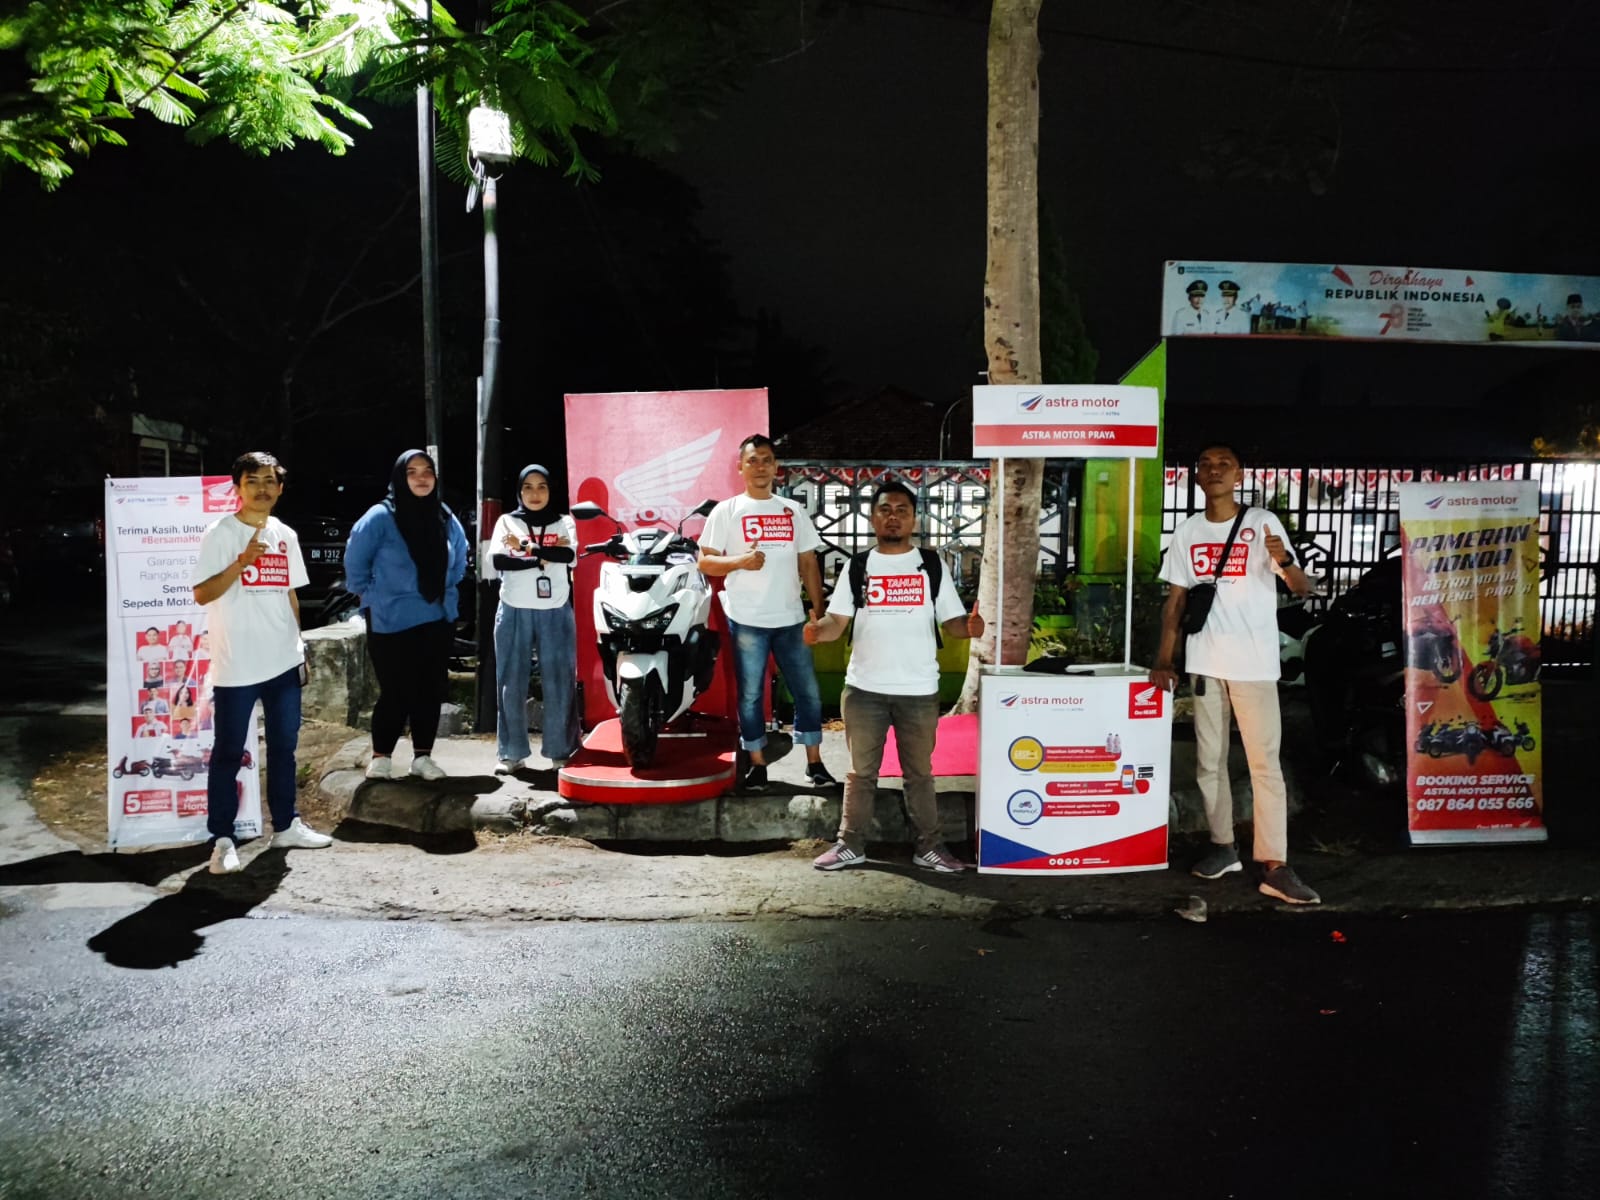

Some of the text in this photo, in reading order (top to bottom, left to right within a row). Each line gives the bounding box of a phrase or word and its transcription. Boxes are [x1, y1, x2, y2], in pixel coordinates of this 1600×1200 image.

[1325, 289, 1485, 303] REPUBLIK INDONESIA
[1045, 396, 1120, 408] astra motor
[1022, 430, 1116, 440] ASTRA MOTOR PRAYA
[1447, 495, 1519, 506] astra motor
[762, 517, 791, 525] TAHUN
[118, 526, 149, 535] Terima
[745, 518, 763, 540] 5
[1409, 524, 1532, 554] PAMERAN
[1211, 546, 1247, 556] TAUN
[147, 556, 187, 567] Garansi
[1194, 547, 1210, 574] 5
[1426, 548, 1513, 574] HONDA
[139, 570, 188, 582] Rangka 5
[886, 578, 922, 588] TAHUN
[868, 578, 886, 603] 5
[886, 588, 922, 596] GARANSI
[122, 599, 163, 610] Sepeda
[1021, 695, 1084, 705] astra motor
[1416, 774, 1535, 786] BOOKING SERVICE
[1458, 787, 1493, 795] MOTOR
[1494, 786, 1527, 794] PRAYA
[126, 794, 141, 812] 5
[1416, 797, 1534, 811] 087 864 055 666
